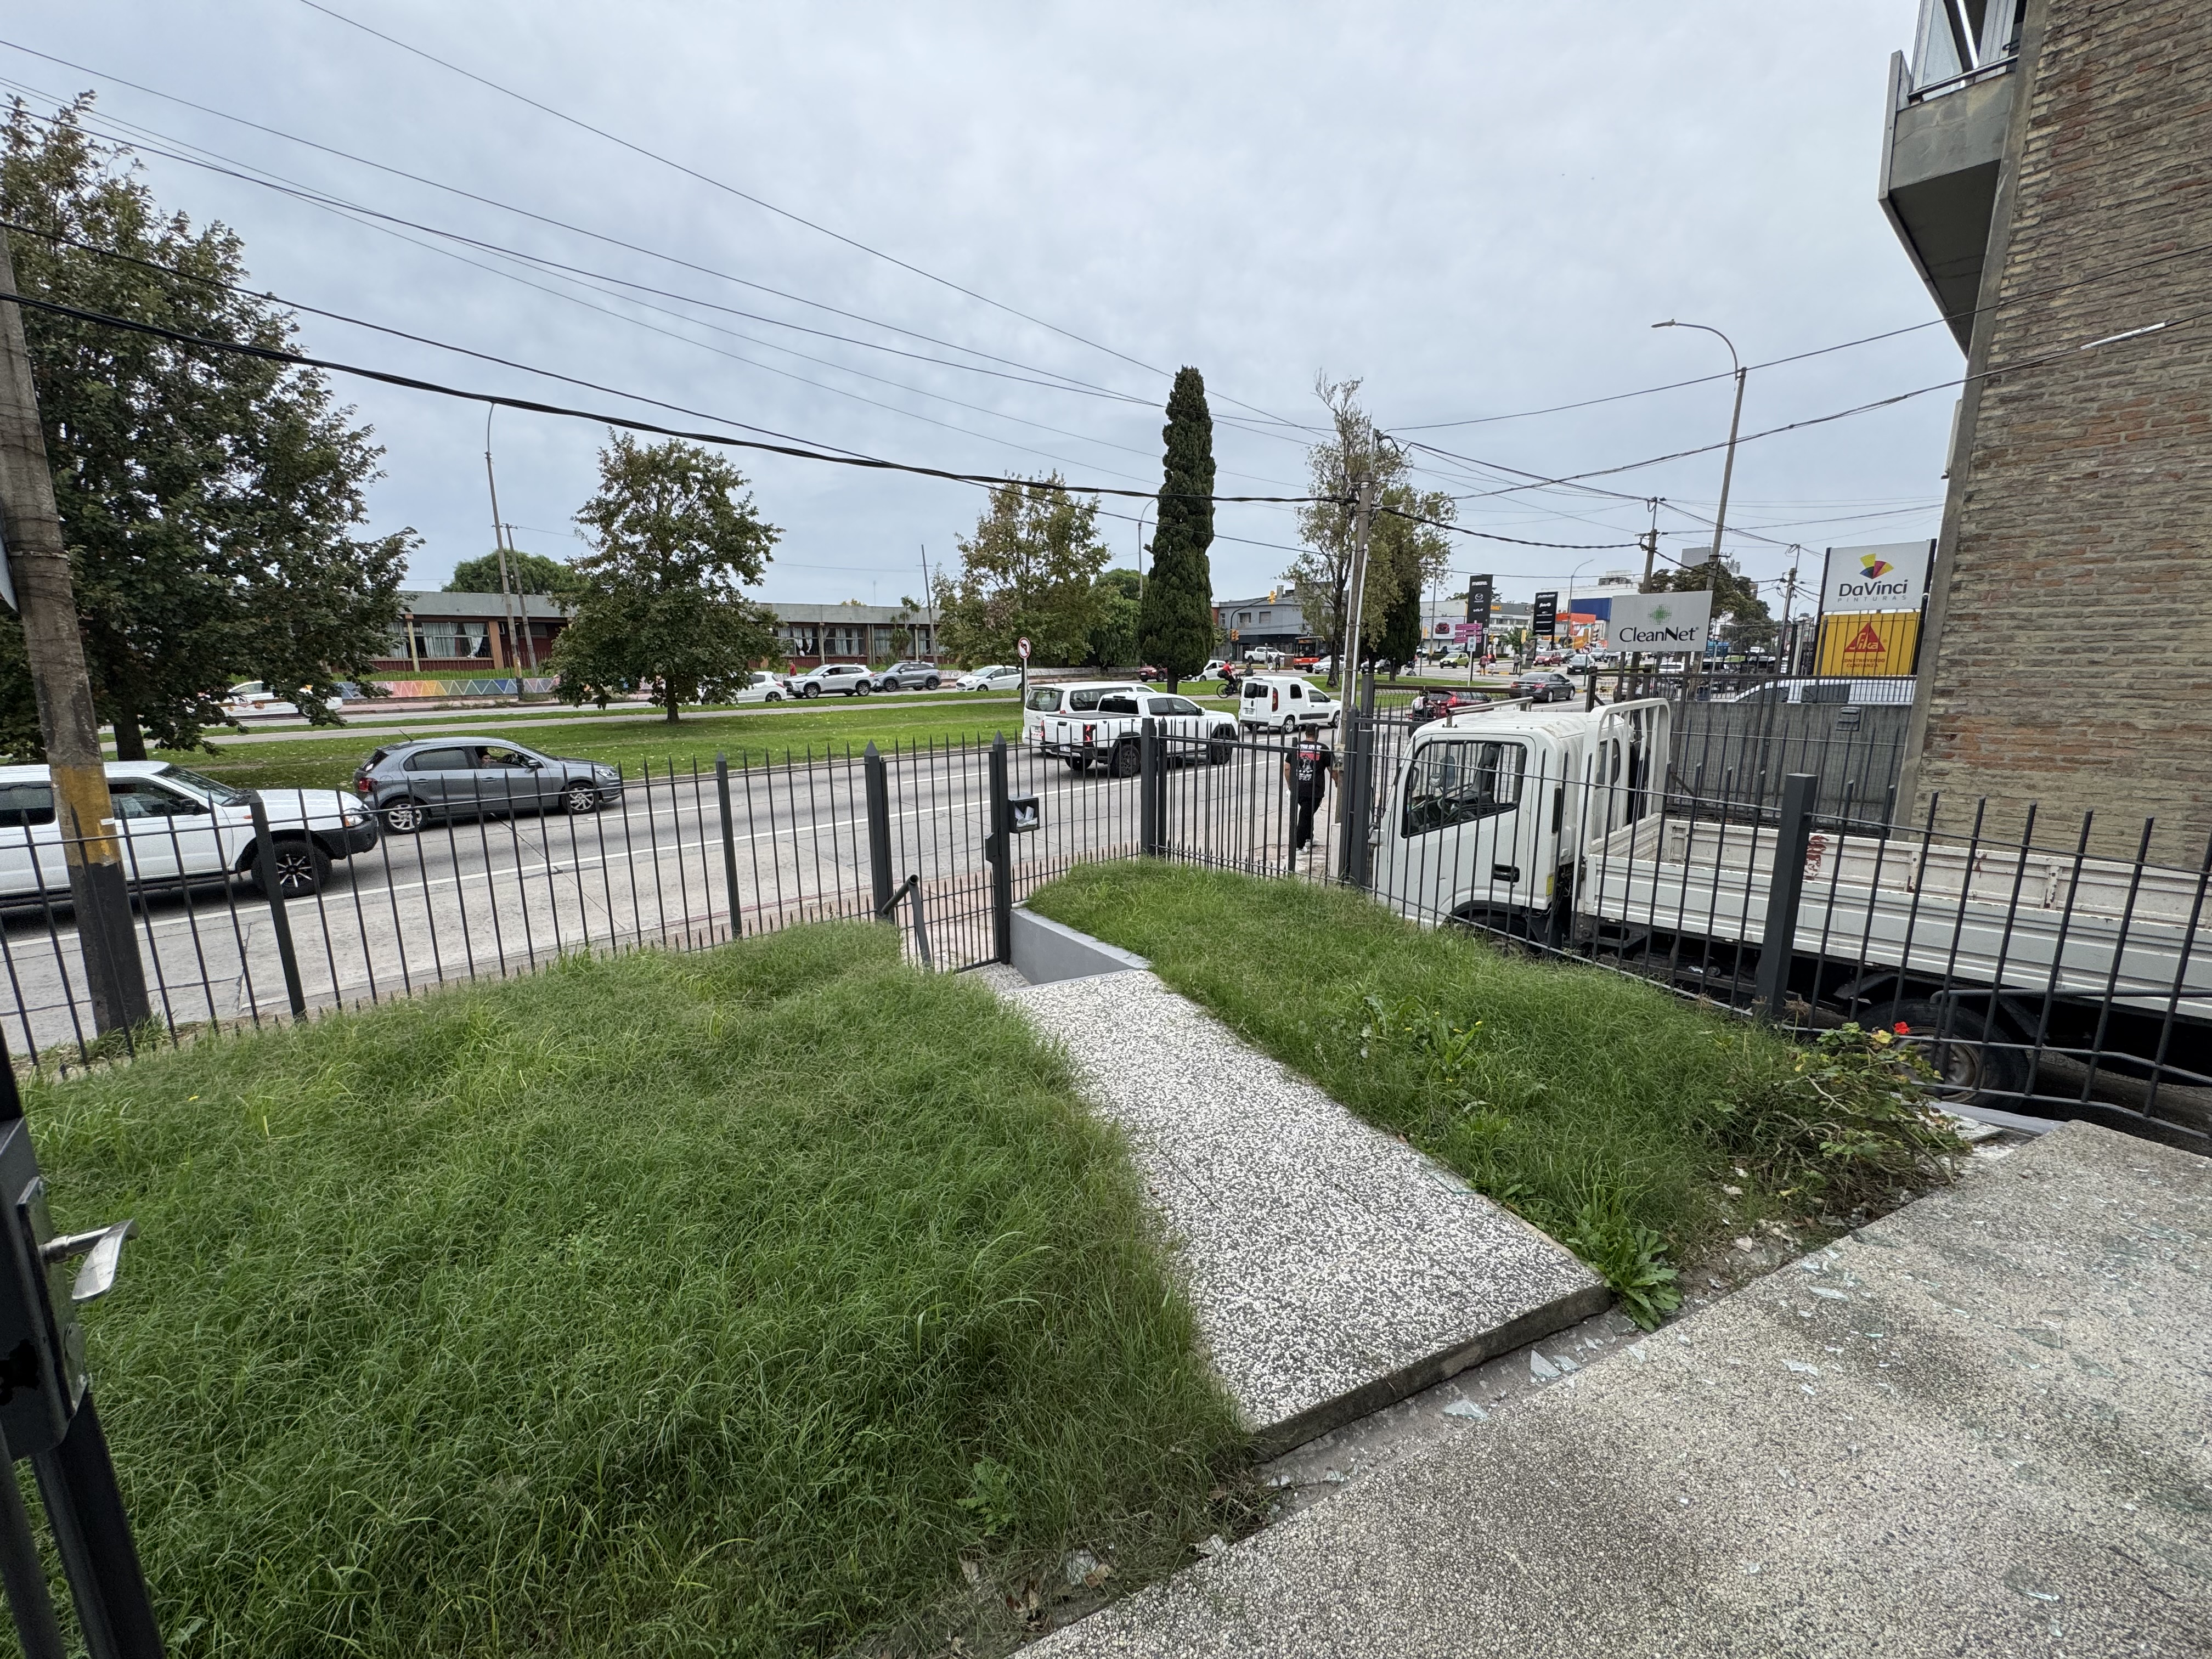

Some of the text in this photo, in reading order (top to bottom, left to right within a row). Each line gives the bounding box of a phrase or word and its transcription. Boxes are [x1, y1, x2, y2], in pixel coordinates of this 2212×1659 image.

[1839, 579, 1908, 597] DaVinci
[1620, 627, 1696, 642] CleanNet
[1849, 632, 1879, 650] Sika
